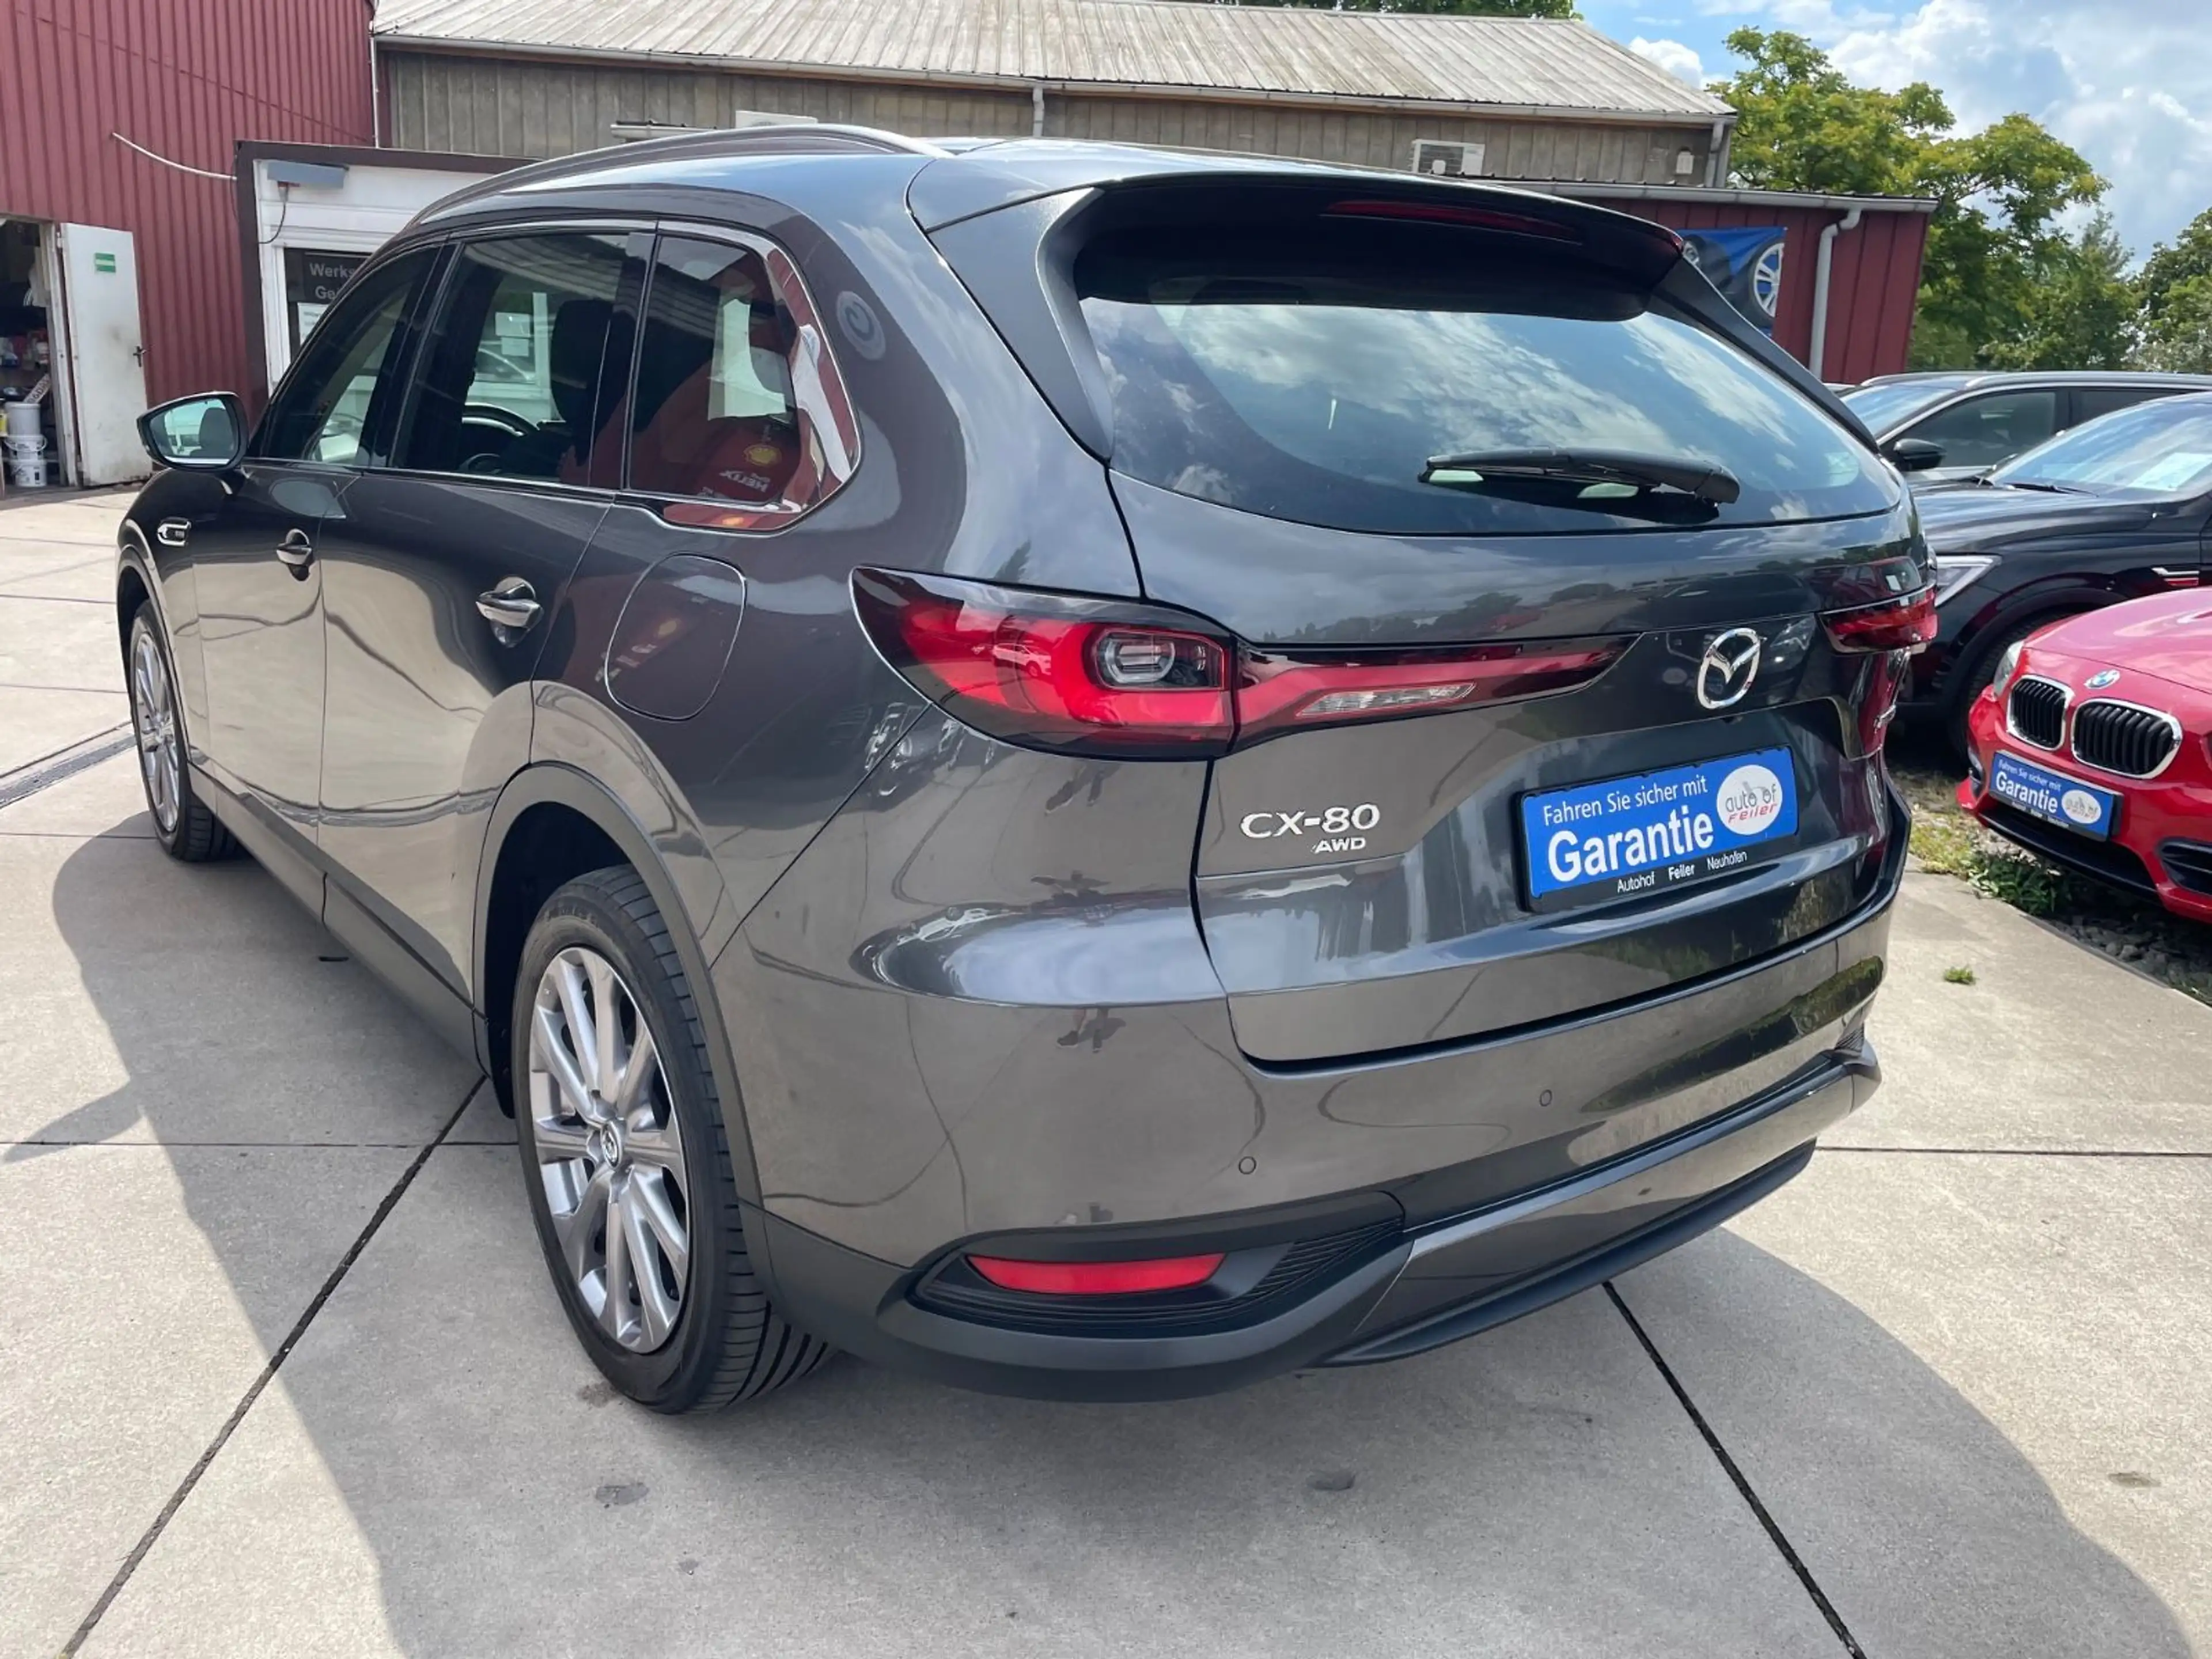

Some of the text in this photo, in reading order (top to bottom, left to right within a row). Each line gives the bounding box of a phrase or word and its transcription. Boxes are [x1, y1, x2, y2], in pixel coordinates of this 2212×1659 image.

[315, 286, 341, 300] Ge
[1544, 774, 1708, 826] Fahren Sie sicher mit
[1996, 771, 2058, 813] Garantie
[1241, 803, 1381, 839] CX-80
[1312, 837, 1366, 854] AWD
[1548, 805, 1714, 882] Garantie
[1617, 851, 1747, 893] Autohof Feiler Neuhofen
